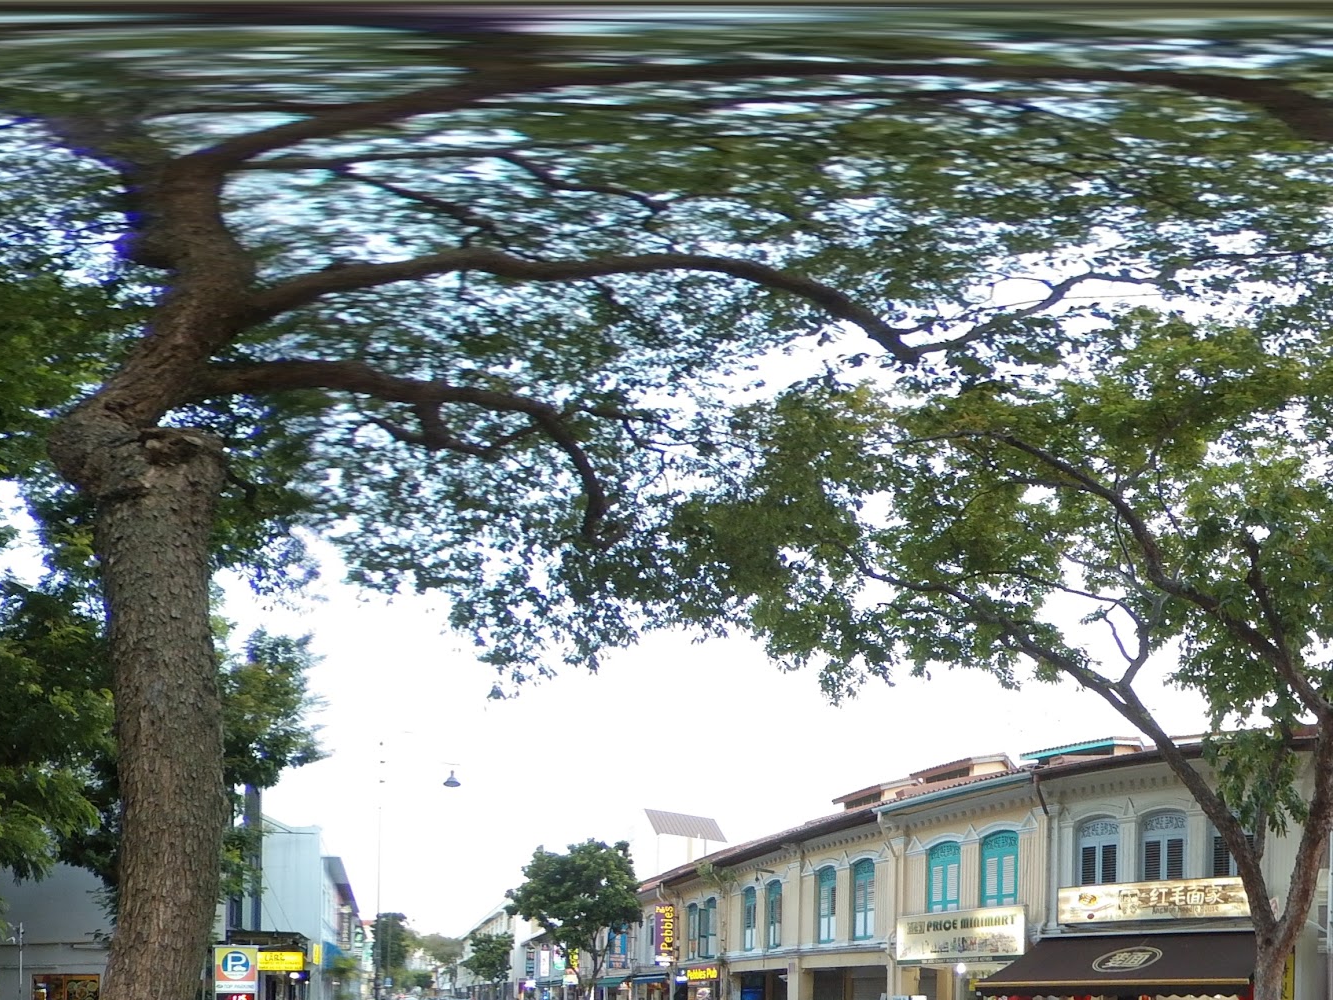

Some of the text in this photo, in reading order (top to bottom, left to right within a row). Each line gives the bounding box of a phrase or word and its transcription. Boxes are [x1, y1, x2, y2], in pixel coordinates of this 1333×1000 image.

[660, 906, 674, 952] Pebbles
[926, 919, 958, 932] PRICE
[960, 914, 1017, 929] MINIMART
[687, 967, 718, 980] Pebbles Pub
